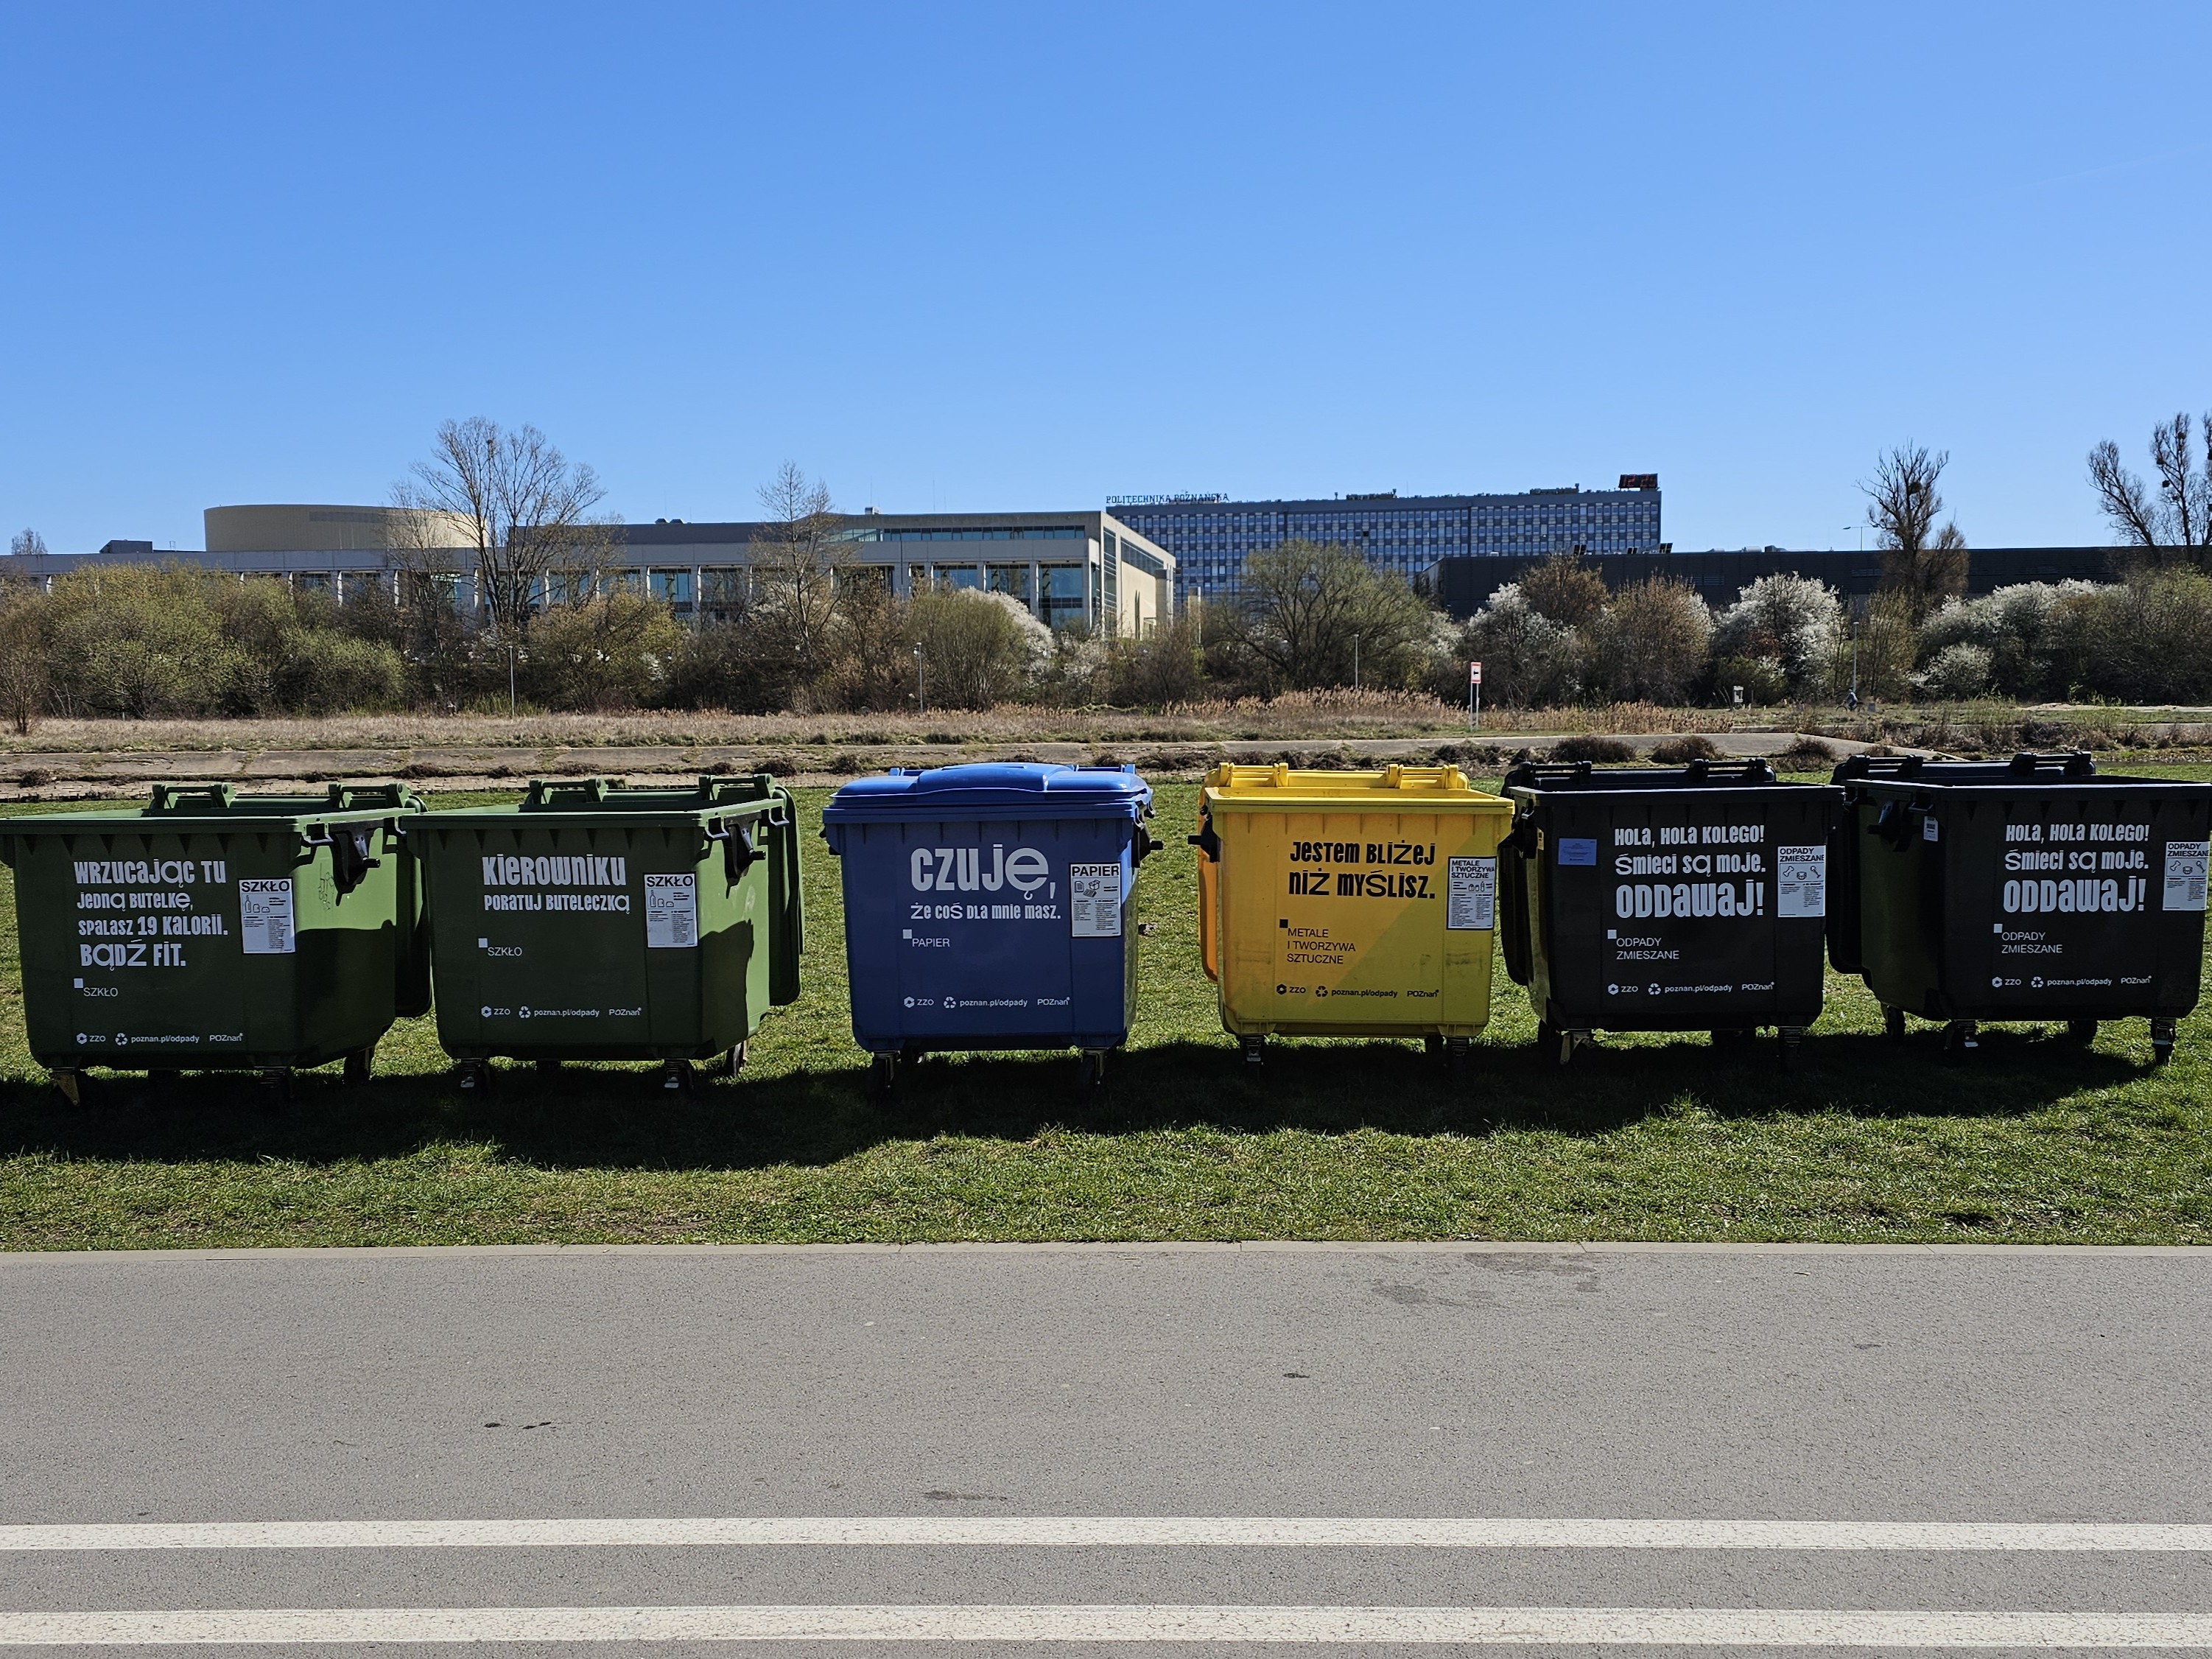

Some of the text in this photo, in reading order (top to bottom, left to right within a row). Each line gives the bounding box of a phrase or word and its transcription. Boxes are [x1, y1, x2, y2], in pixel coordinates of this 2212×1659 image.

[1106, 495, 1171, 504] POLITECHNIKA
[1072, 866, 1119, 877] PAPIER
[242, 880, 290, 892] SZKŁO
[647, 876, 693, 887] SZKŁO
[138, 916, 157, 935] 19
[1288, 928, 1329, 938] METALE
[2003, 932, 2046, 941] ODPADY
[913, 939, 949, 947] PAPIER
[1288, 941, 1355, 951] I TWORZYWA
[1617, 938, 1661, 947] ODPADY
[488, 947, 522, 956] SZKŁO
[2002, 944, 2062, 953] ZMIESZANE
[1287, 953, 1344, 964] SZTUCZNE
[1617, 950, 1679, 959] ZMIESZANE
[2048, 978, 2112, 986] poznan.pl/odpady
[84, 987, 118, 997] SZKŁO
[1332, 989, 1397, 998] poznan.pl/odpady
[1665, 985, 1732, 993] poznan.pl/odpady
[960, 999, 1028, 1007] poznan.pl/odpady
[534, 1009, 600, 1017] poznan.pl/odpady
[131, 1035, 200, 1043] poznan.pl/odpady
